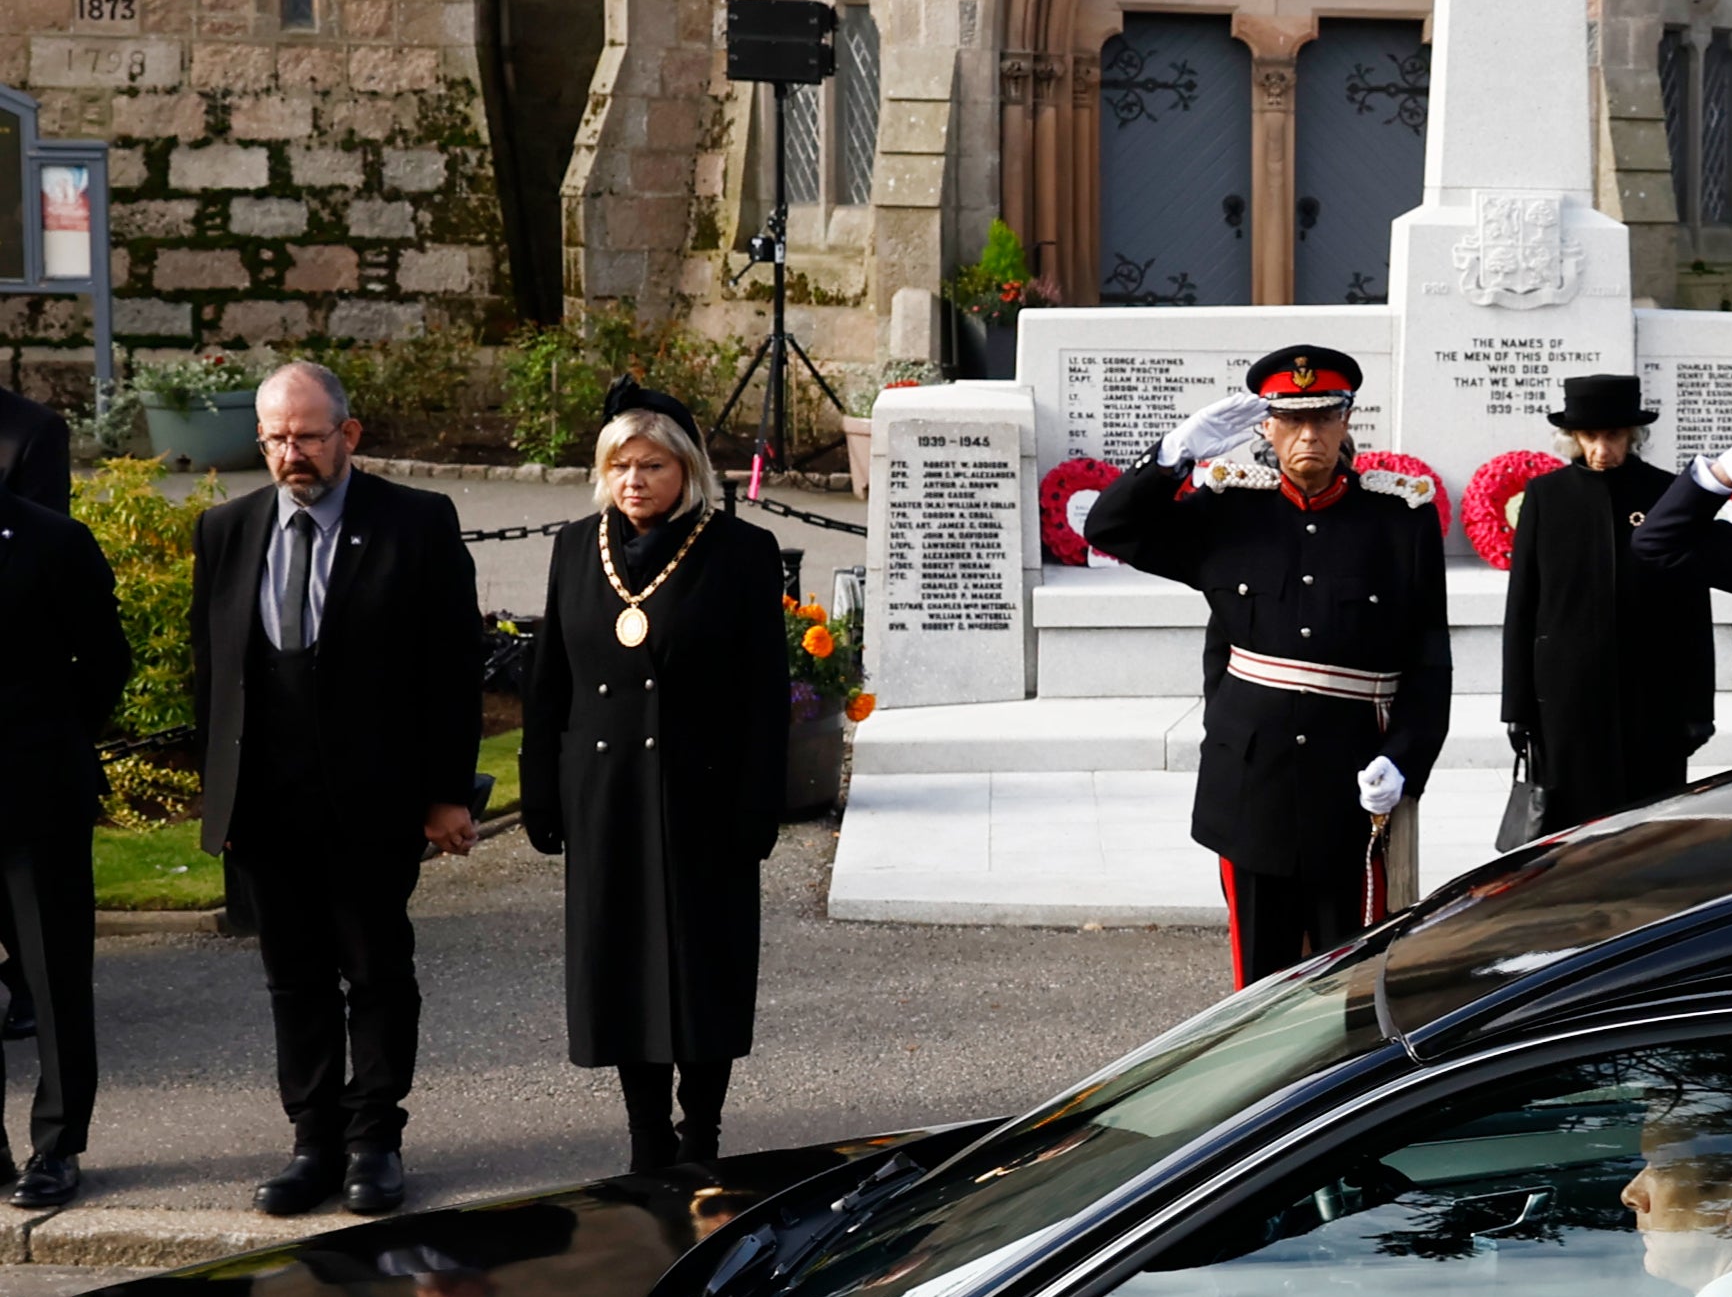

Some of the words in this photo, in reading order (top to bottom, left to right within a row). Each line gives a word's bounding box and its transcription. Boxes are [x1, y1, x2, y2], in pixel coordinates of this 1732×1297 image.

[67, 49, 146, 76] 1798
[1473, 338, 1494, 348] THE
[1501, 339, 1543, 348] NAMES
[1549, 339, 1563, 348] OF
[1435, 351, 1457, 361] THE
[1465, 352, 1490, 361] MEN
[1495, 352, 1508, 361] OF
[1515, 352, 1541, 361] THIS
[1548, 352, 1600, 361] DISTRICT
[1488, 365, 1515, 373] WHO
[1523, 365, 1548, 374] DIED
[1454, 378, 1484, 387] THAT
[1490, 377, 1507, 387] WE
[1515, 378, 1551, 387] MIGHT
[918, 436, 946, 447] 1939
[960, 437, 990, 447] 1945
